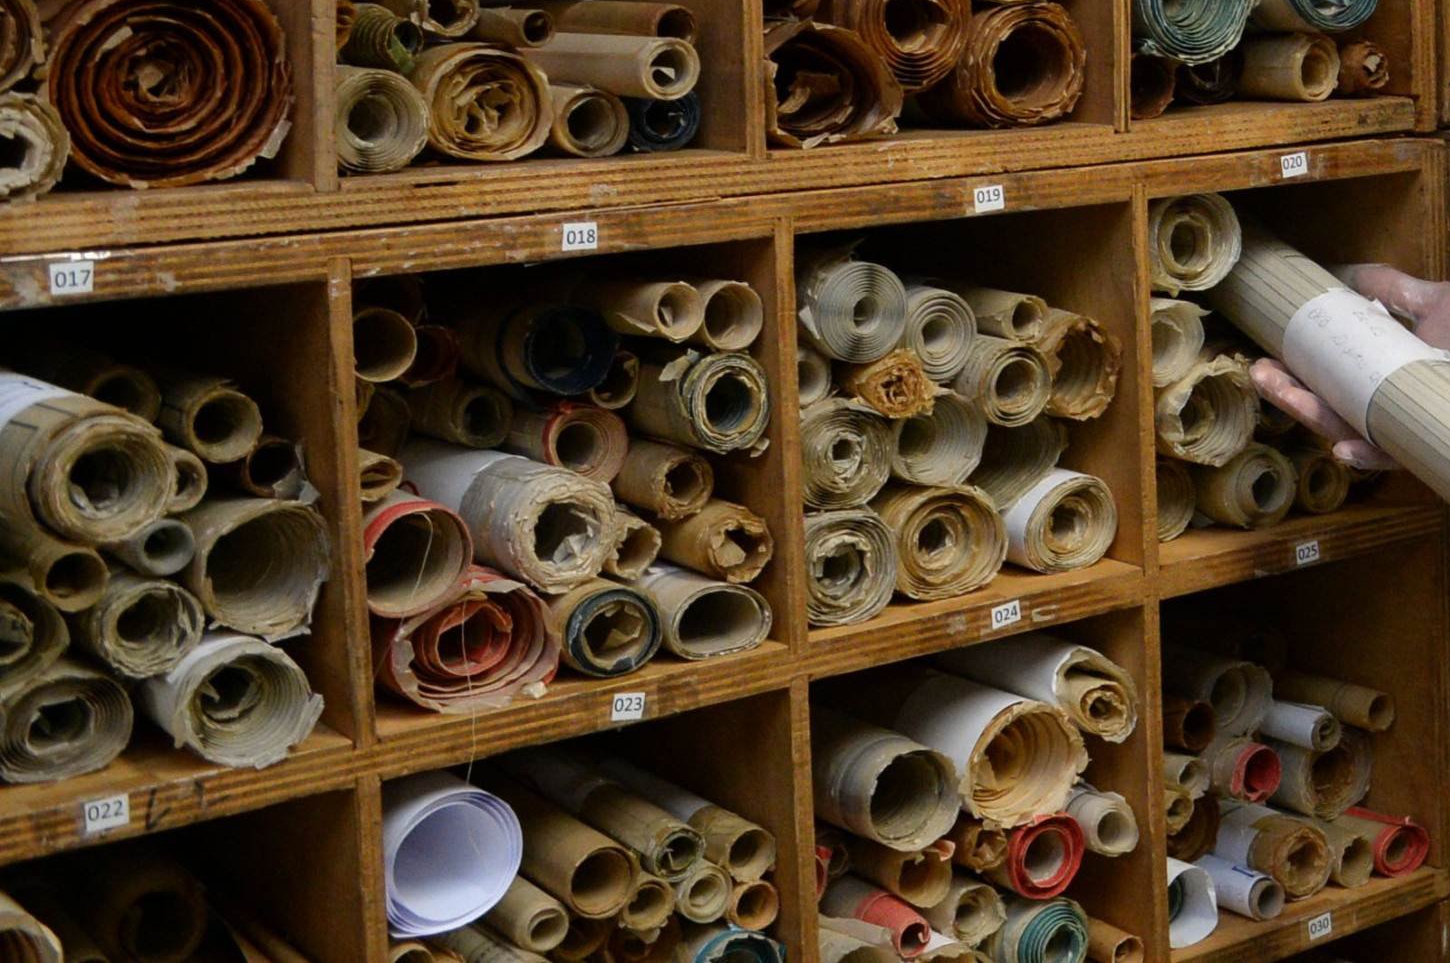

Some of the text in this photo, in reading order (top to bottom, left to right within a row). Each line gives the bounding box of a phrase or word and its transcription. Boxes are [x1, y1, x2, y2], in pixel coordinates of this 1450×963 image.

[1282, 155, 1303, 170] 020
[976, 189, 1001, 203] 019
[566, 229, 596, 245] 018
[55, 270, 91, 288] 017
[1298, 544, 1318, 560] 025
[994, 605, 1018, 623] 024
[614, 697, 642, 712] 023
[88, 800, 123, 822] 022
[1310, 917, 1330, 934] 030
